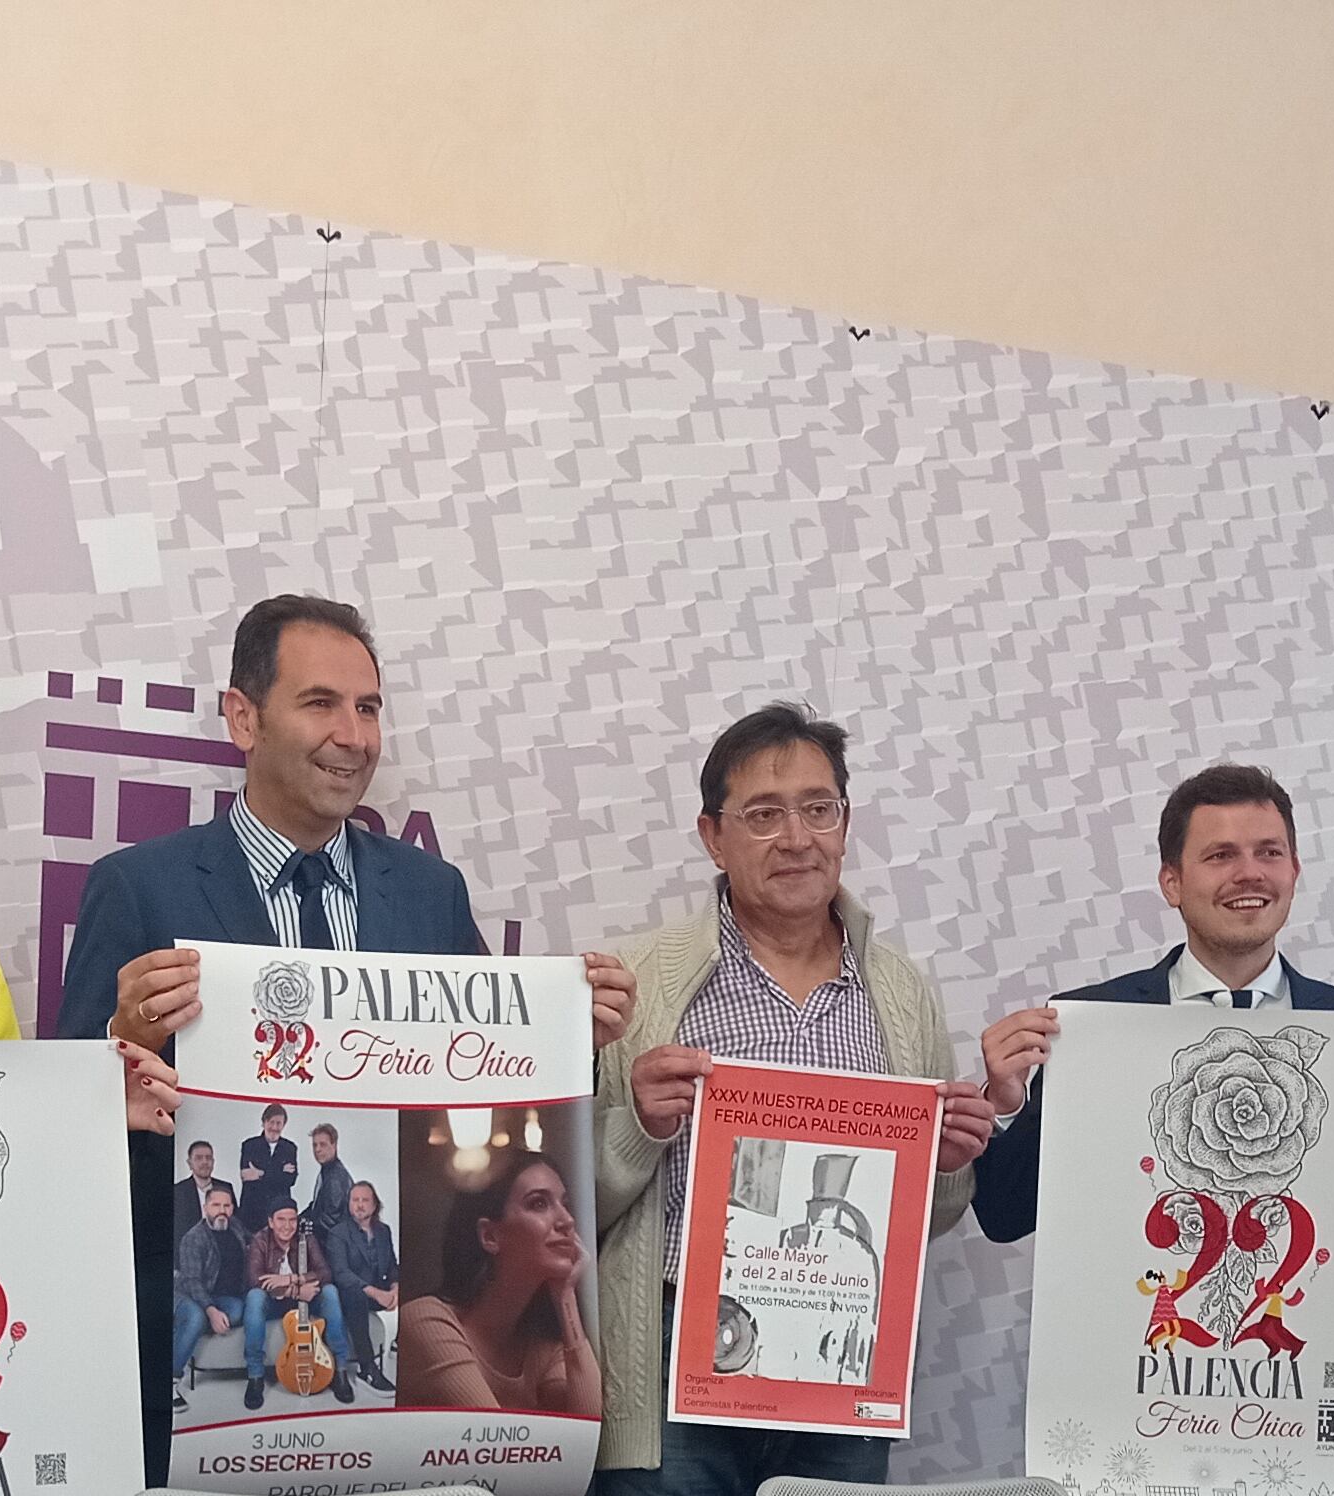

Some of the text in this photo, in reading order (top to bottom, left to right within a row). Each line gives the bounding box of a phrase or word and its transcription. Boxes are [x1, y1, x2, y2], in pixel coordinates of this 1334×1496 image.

[320, 966, 532, 1027] PALENCIA
[255, 1021, 537, 1084] 22 Feria Chica
[708, 1087, 930, 1122] XXXV MUESTRA DE CERÁMICA
[714, 1108, 918, 1141] FERIA CHICA PALENCIA 2022
[744, 1245, 829, 1267] Calle Mayor
[742, 1265, 869, 1288] del 2 al 5 de Junio
[1145, 1191, 1316, 1347] 22
[738, 1295, 868, 1314] DEMOSTRACIONES VIVO
[1136, 1356, 1303, 1400] PALENCIA
[684, 1386, 710, 1396] CEPA
[1135, 1401, 1306, 1440] Feria Chica
[252, 1432, 324, 1450] 3 JUNIO
[460, 1426, 530, 1443] 4 JUNIO
[198, 1451, 372, 1475] LOS SECRETOS
[420, 1445, 562, 1467] ANA GUERRA
